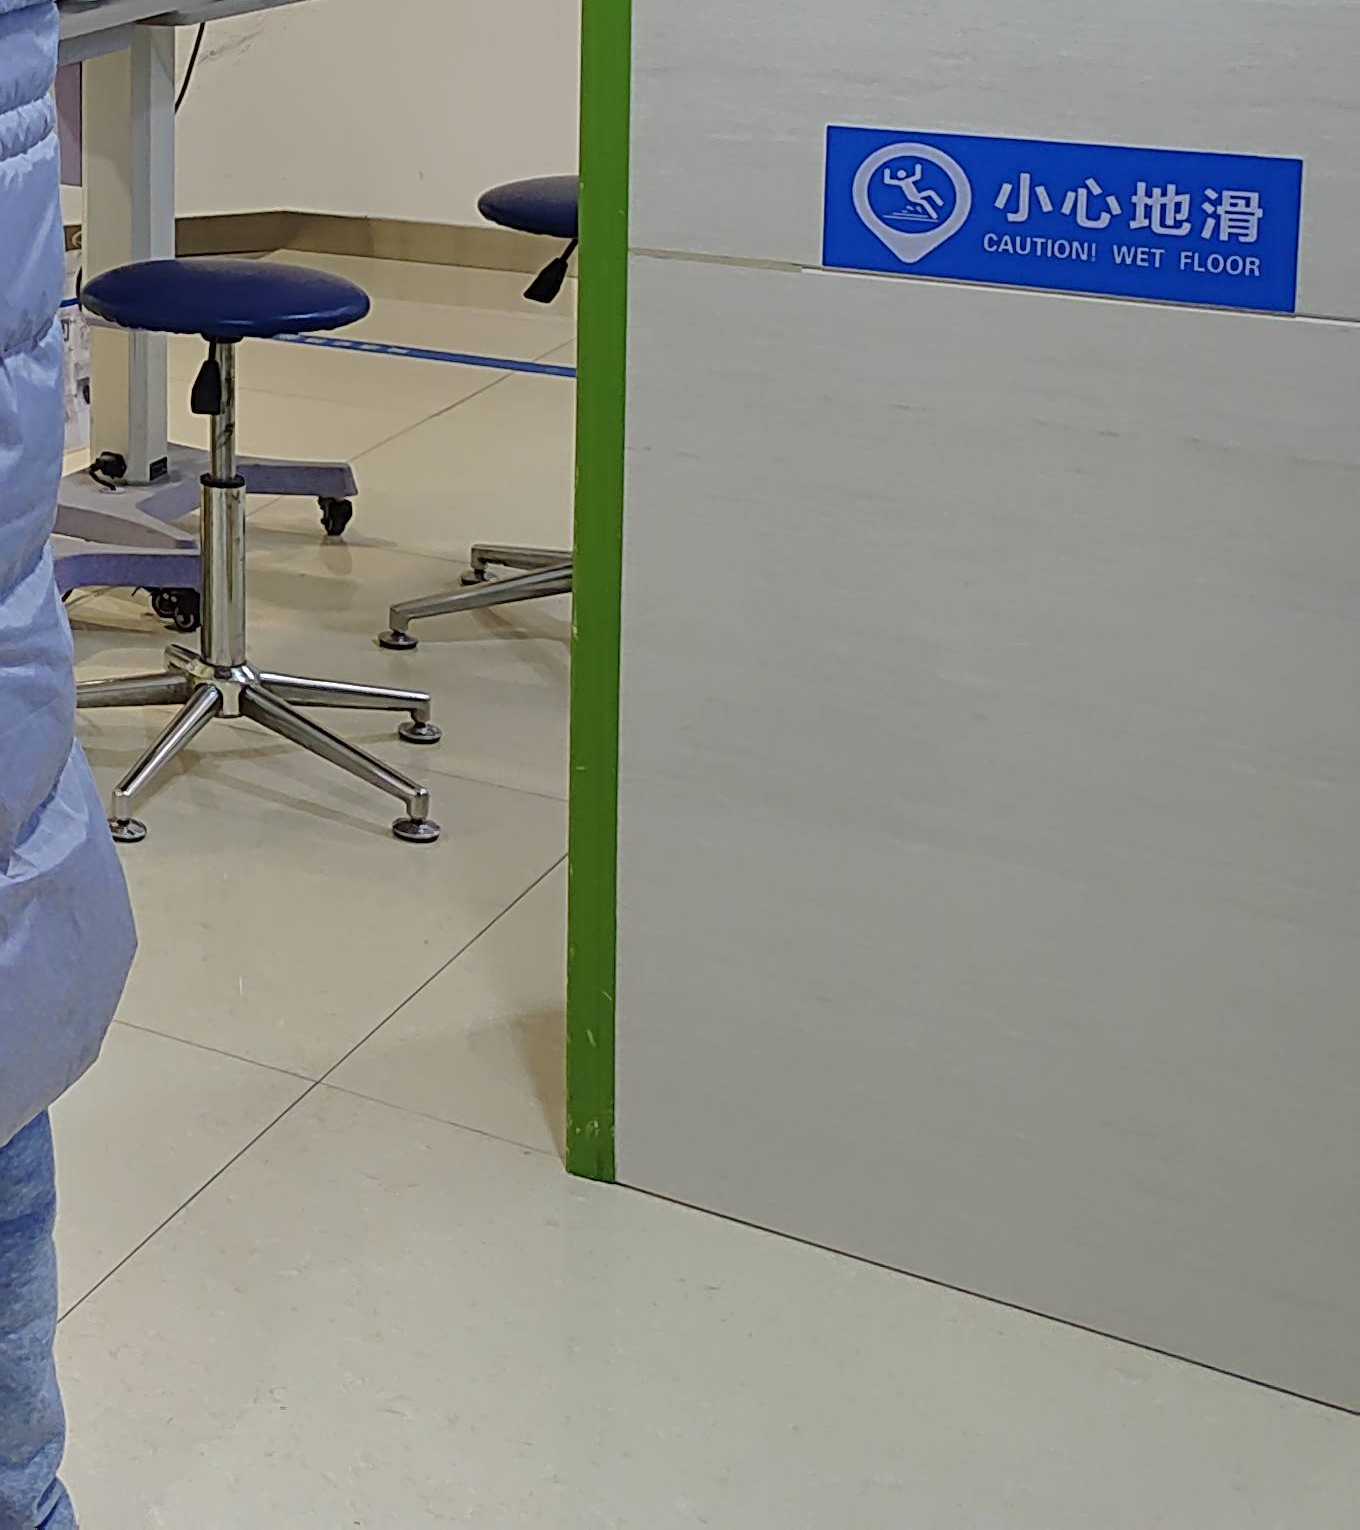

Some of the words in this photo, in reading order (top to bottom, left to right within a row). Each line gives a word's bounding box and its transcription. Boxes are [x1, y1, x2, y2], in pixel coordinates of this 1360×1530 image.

[993, 172, 1264, 243] 小心地滑
[983, 233, 1097, 262] CAUTION!
[1113, 245, 1165, 268] WET
[1180, 251, 1261, 277] FLOOR
